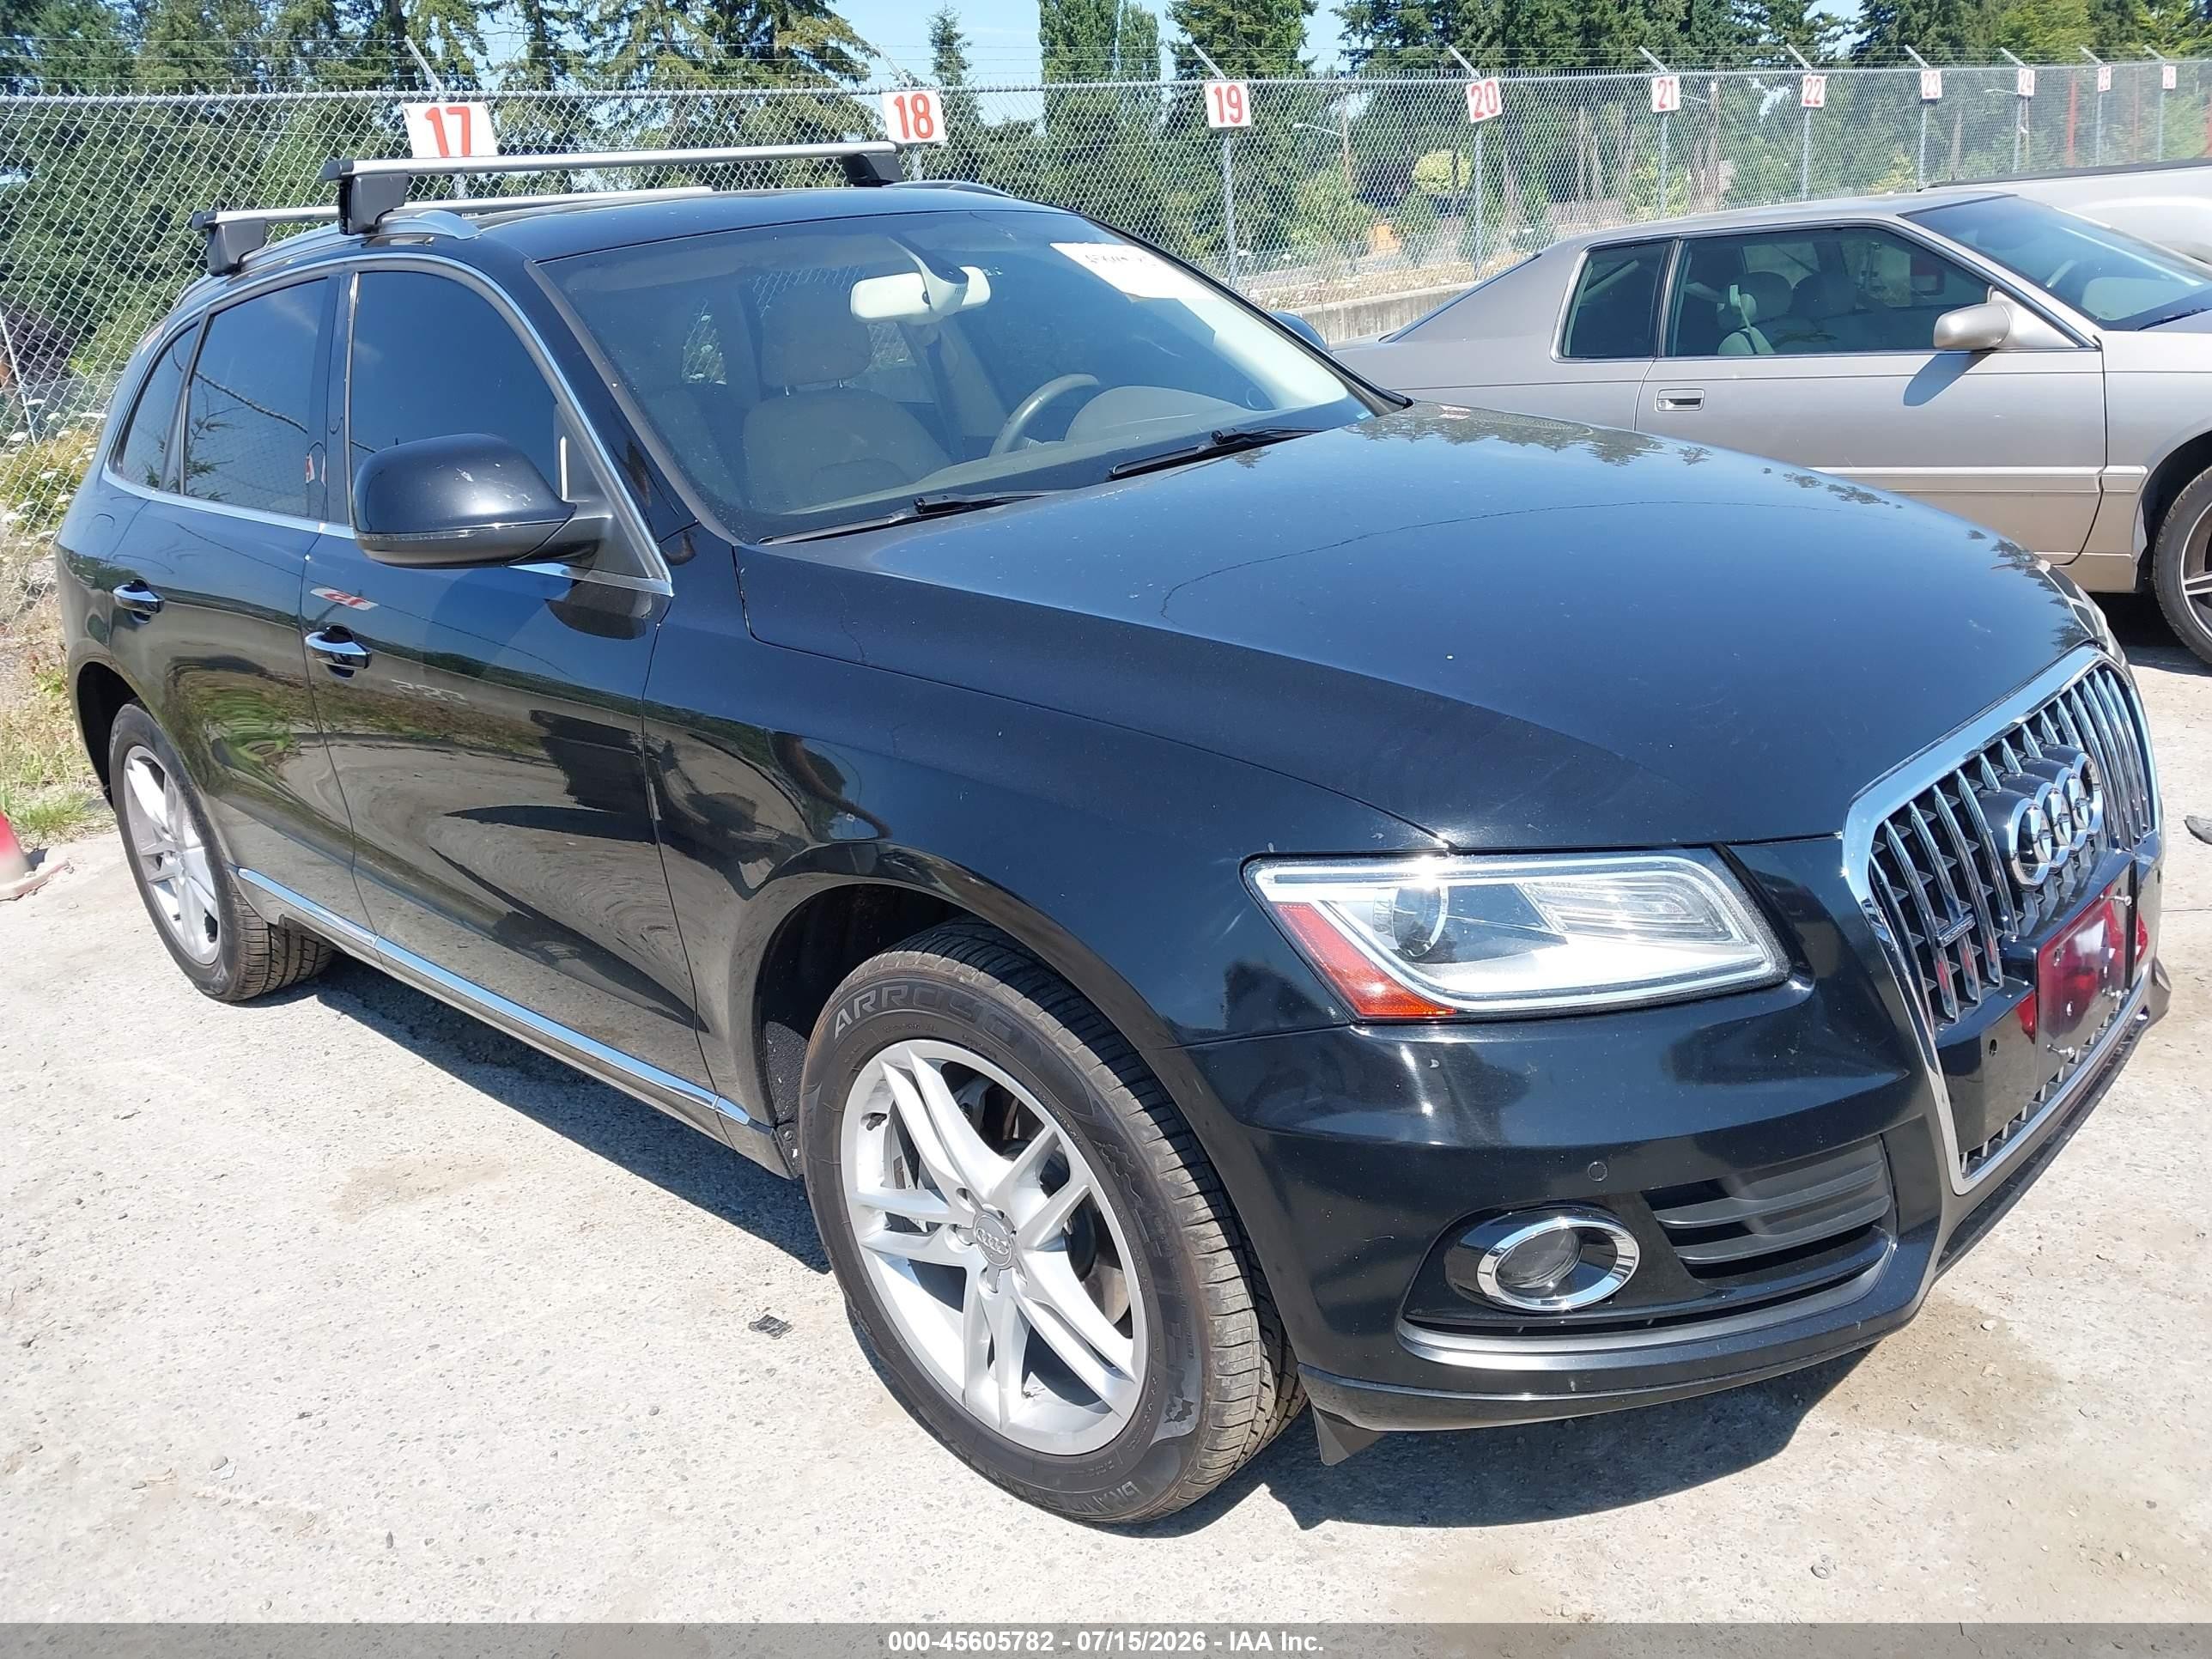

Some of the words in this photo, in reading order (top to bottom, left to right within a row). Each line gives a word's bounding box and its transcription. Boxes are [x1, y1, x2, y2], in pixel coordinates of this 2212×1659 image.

[1657, 78, 1674, 109] 21
[1805, 77, 1822, 105] 22
[1923, 72, 1939, 96] 23
[2020, 70, 2033, 94] 24
[893, 93, 934, 139] 18
[1213, 84, 1243, 124] 19
[1470, 81, 1498, 118] 20
[424, 106, 472, 158] 17
